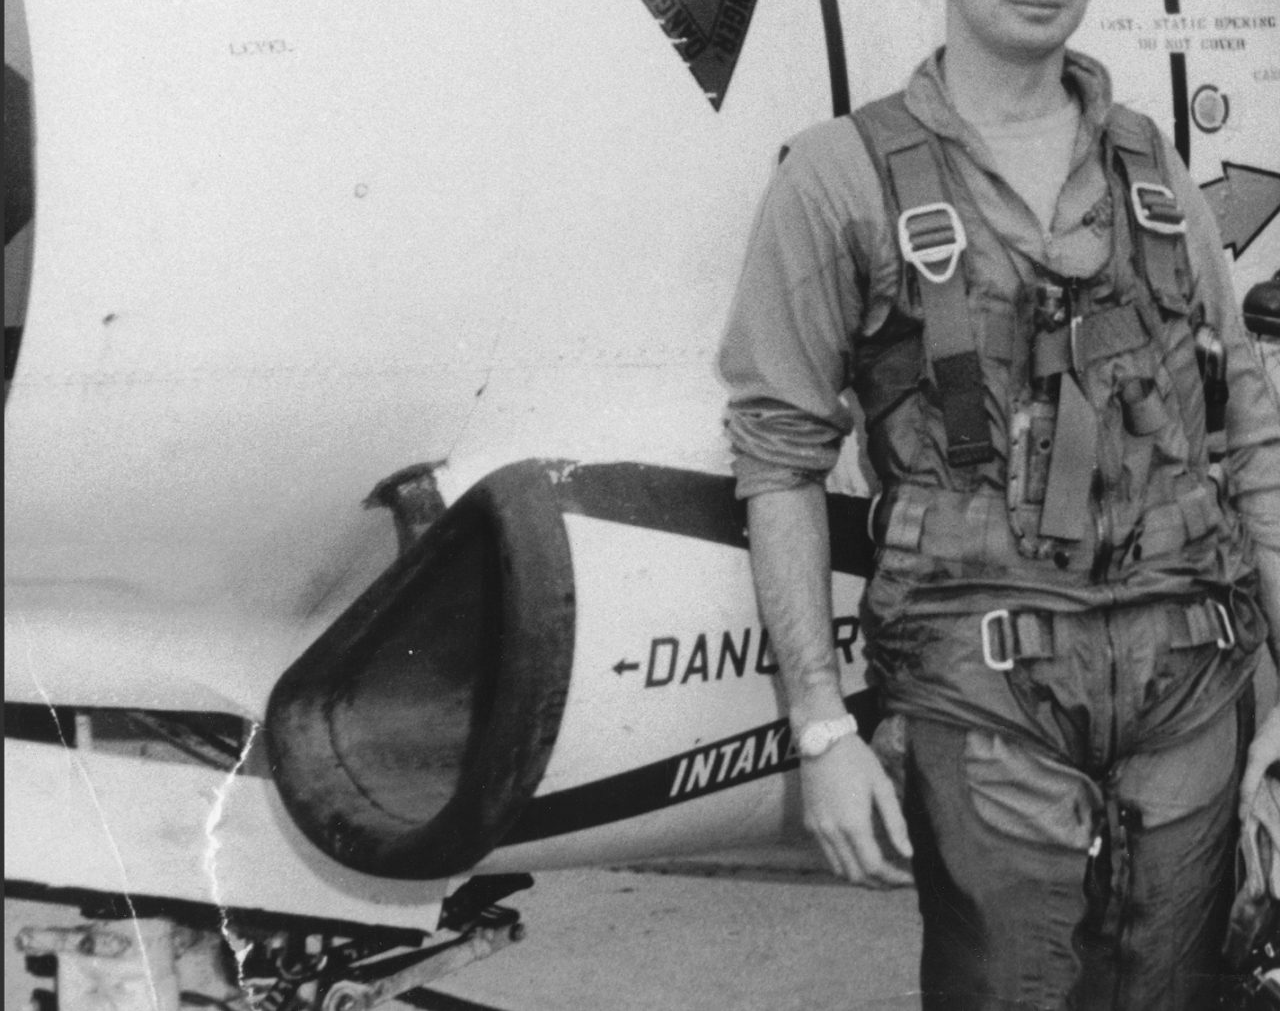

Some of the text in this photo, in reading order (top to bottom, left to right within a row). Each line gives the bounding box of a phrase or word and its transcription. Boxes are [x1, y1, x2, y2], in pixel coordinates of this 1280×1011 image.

[1153, 17, 1207, 30] STATIC
[1214, 16, 1276, 29] OPENING
[1165, 38, 1190, 50] NOT
[1200, 38, 1245, 51] COVER
[645, 616, 860, 688] DANR
